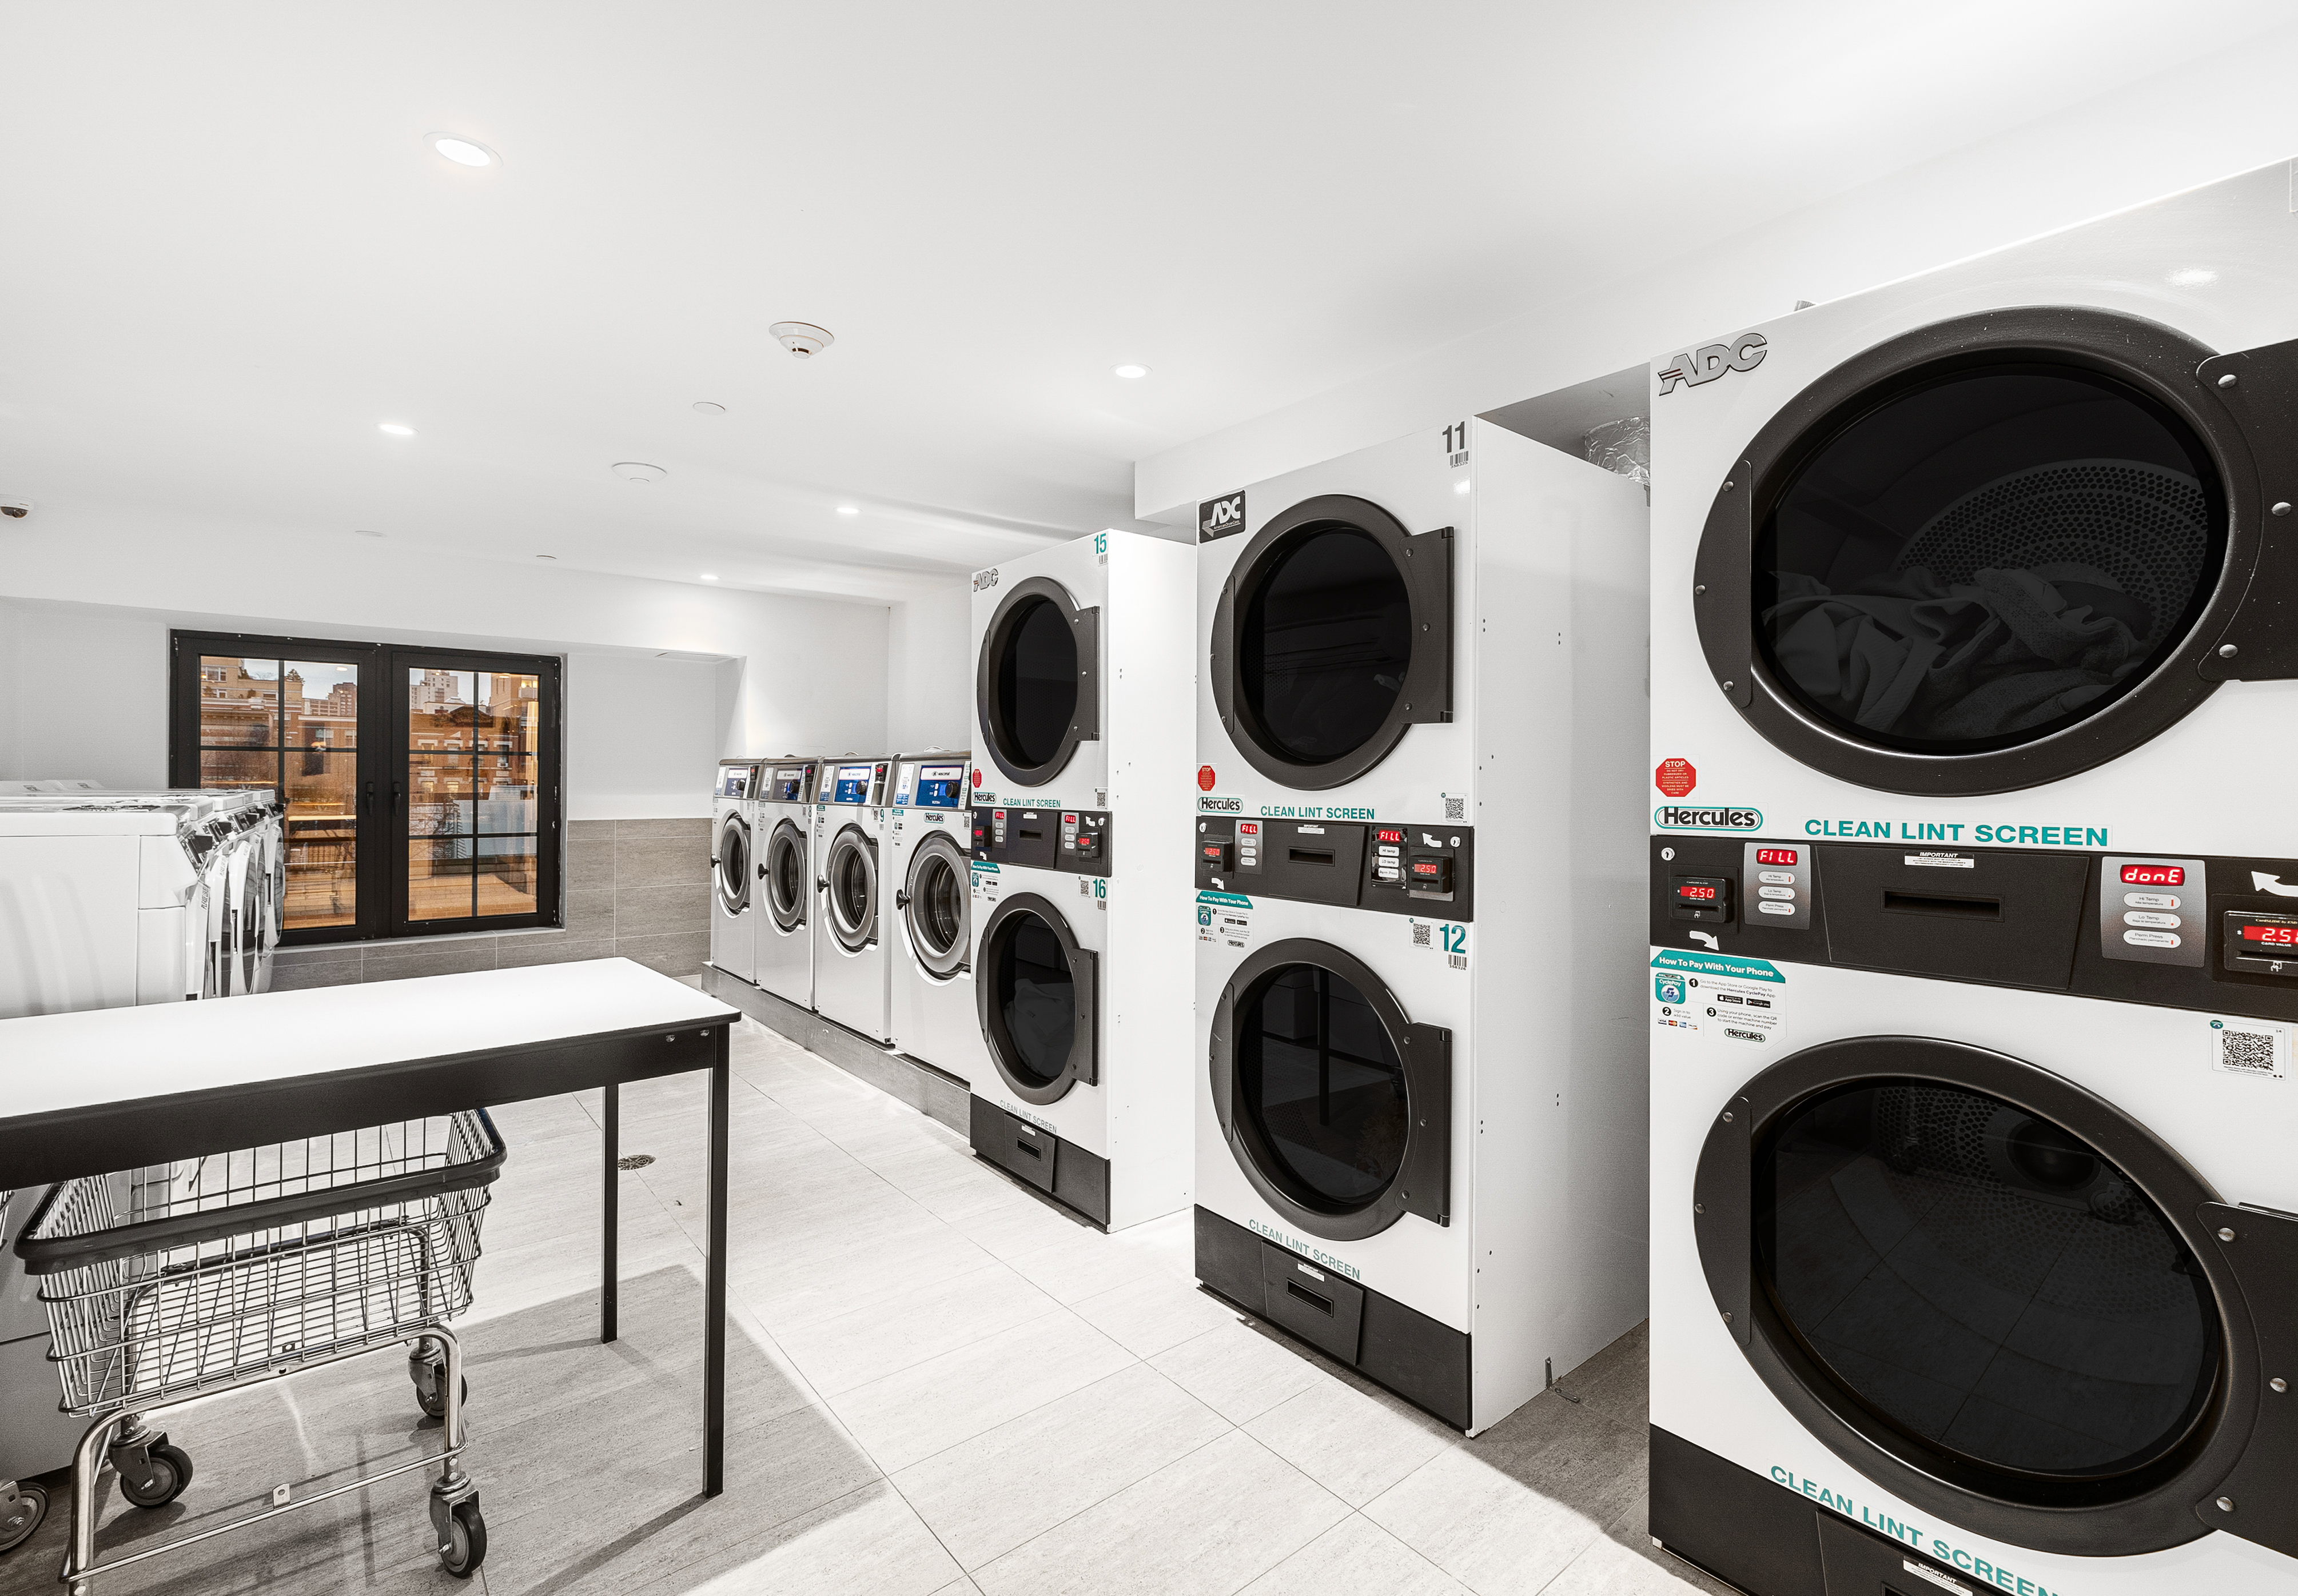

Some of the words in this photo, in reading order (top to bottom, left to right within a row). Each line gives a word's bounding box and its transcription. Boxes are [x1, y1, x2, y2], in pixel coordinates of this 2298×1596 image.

[1658, 333, 1767, 396] ADC
[1442, 421, 1465, 453] 11
[1210, 496, 1241, 526] ADC
[1094, 533, 1106, 554] 15
[973, 568, 998, 592] ADC
[974, 792, 995, 802] Hercules
[1003, 798, 1021, 807] CLEAN
[1022, 799, 1035, 807] LINT
[1036, 799, 1061, 808] SCREEN
[1201, 797, 1240, 811] Hercules
[880, 809, 885, 823] 9
[925, 812, 943, 822] Hercules
[1261, 805, 1295, 817] CLEAN
[1299, 807, 1323, 818] LINT
[1327, 808, 1375, 820] SCREEN
[1664, 807, 1755, 827] Hercules
[1242, 825, 1257, 833] FILL
[1380, 832, 1400, 841] FILL
[1805, 819, 1891, 839] CLEAN
[1901, 822, 1965, 841] LINT
[1974, 825, 2108, 847] SCREEN
[1760, 851, 1794, 863] FILL
[1420, 865, 1436, 873] 2.50
[2125, 868, 2180, 883] donE
[1093, 878, 1106, 899] 16
[1690, 887, 1714, 898] 2.50
[1229, 940, 1244, 948] Hercules
[1440, 924, 1466, 954] 12
[1659, 957, 1677, 965] How
[1678, 959, 1688, 967] To
[1689, 960, 1703, 970] Pay
[1704, 961, 1724, 971] With
[1725, 964, 1745, 973] Your
[1746, 967, 1774, 977] Phone
[1659, 979, 1681, 987] CyclePay
[1727, 1028, 1763, 1041] Hercules
[1000, 1099, 1018, 1115] CLEAN
[1019, 1108, 1031, 1120] LINT
[1033, 1115, 1057, 1134] SCREEN
[1249, 1219, 1283, 1243] CLEAN
[1286, 1235, 1309, 1255] LINT
[1313, 1248, 1360, 1280] SCREEN
[1771, 1465, 1853, 1515] CLEAN
[1863, 1506, 1923, 1546] LINT
[1918, 1562, 1957, 1584] IMPORTANT
